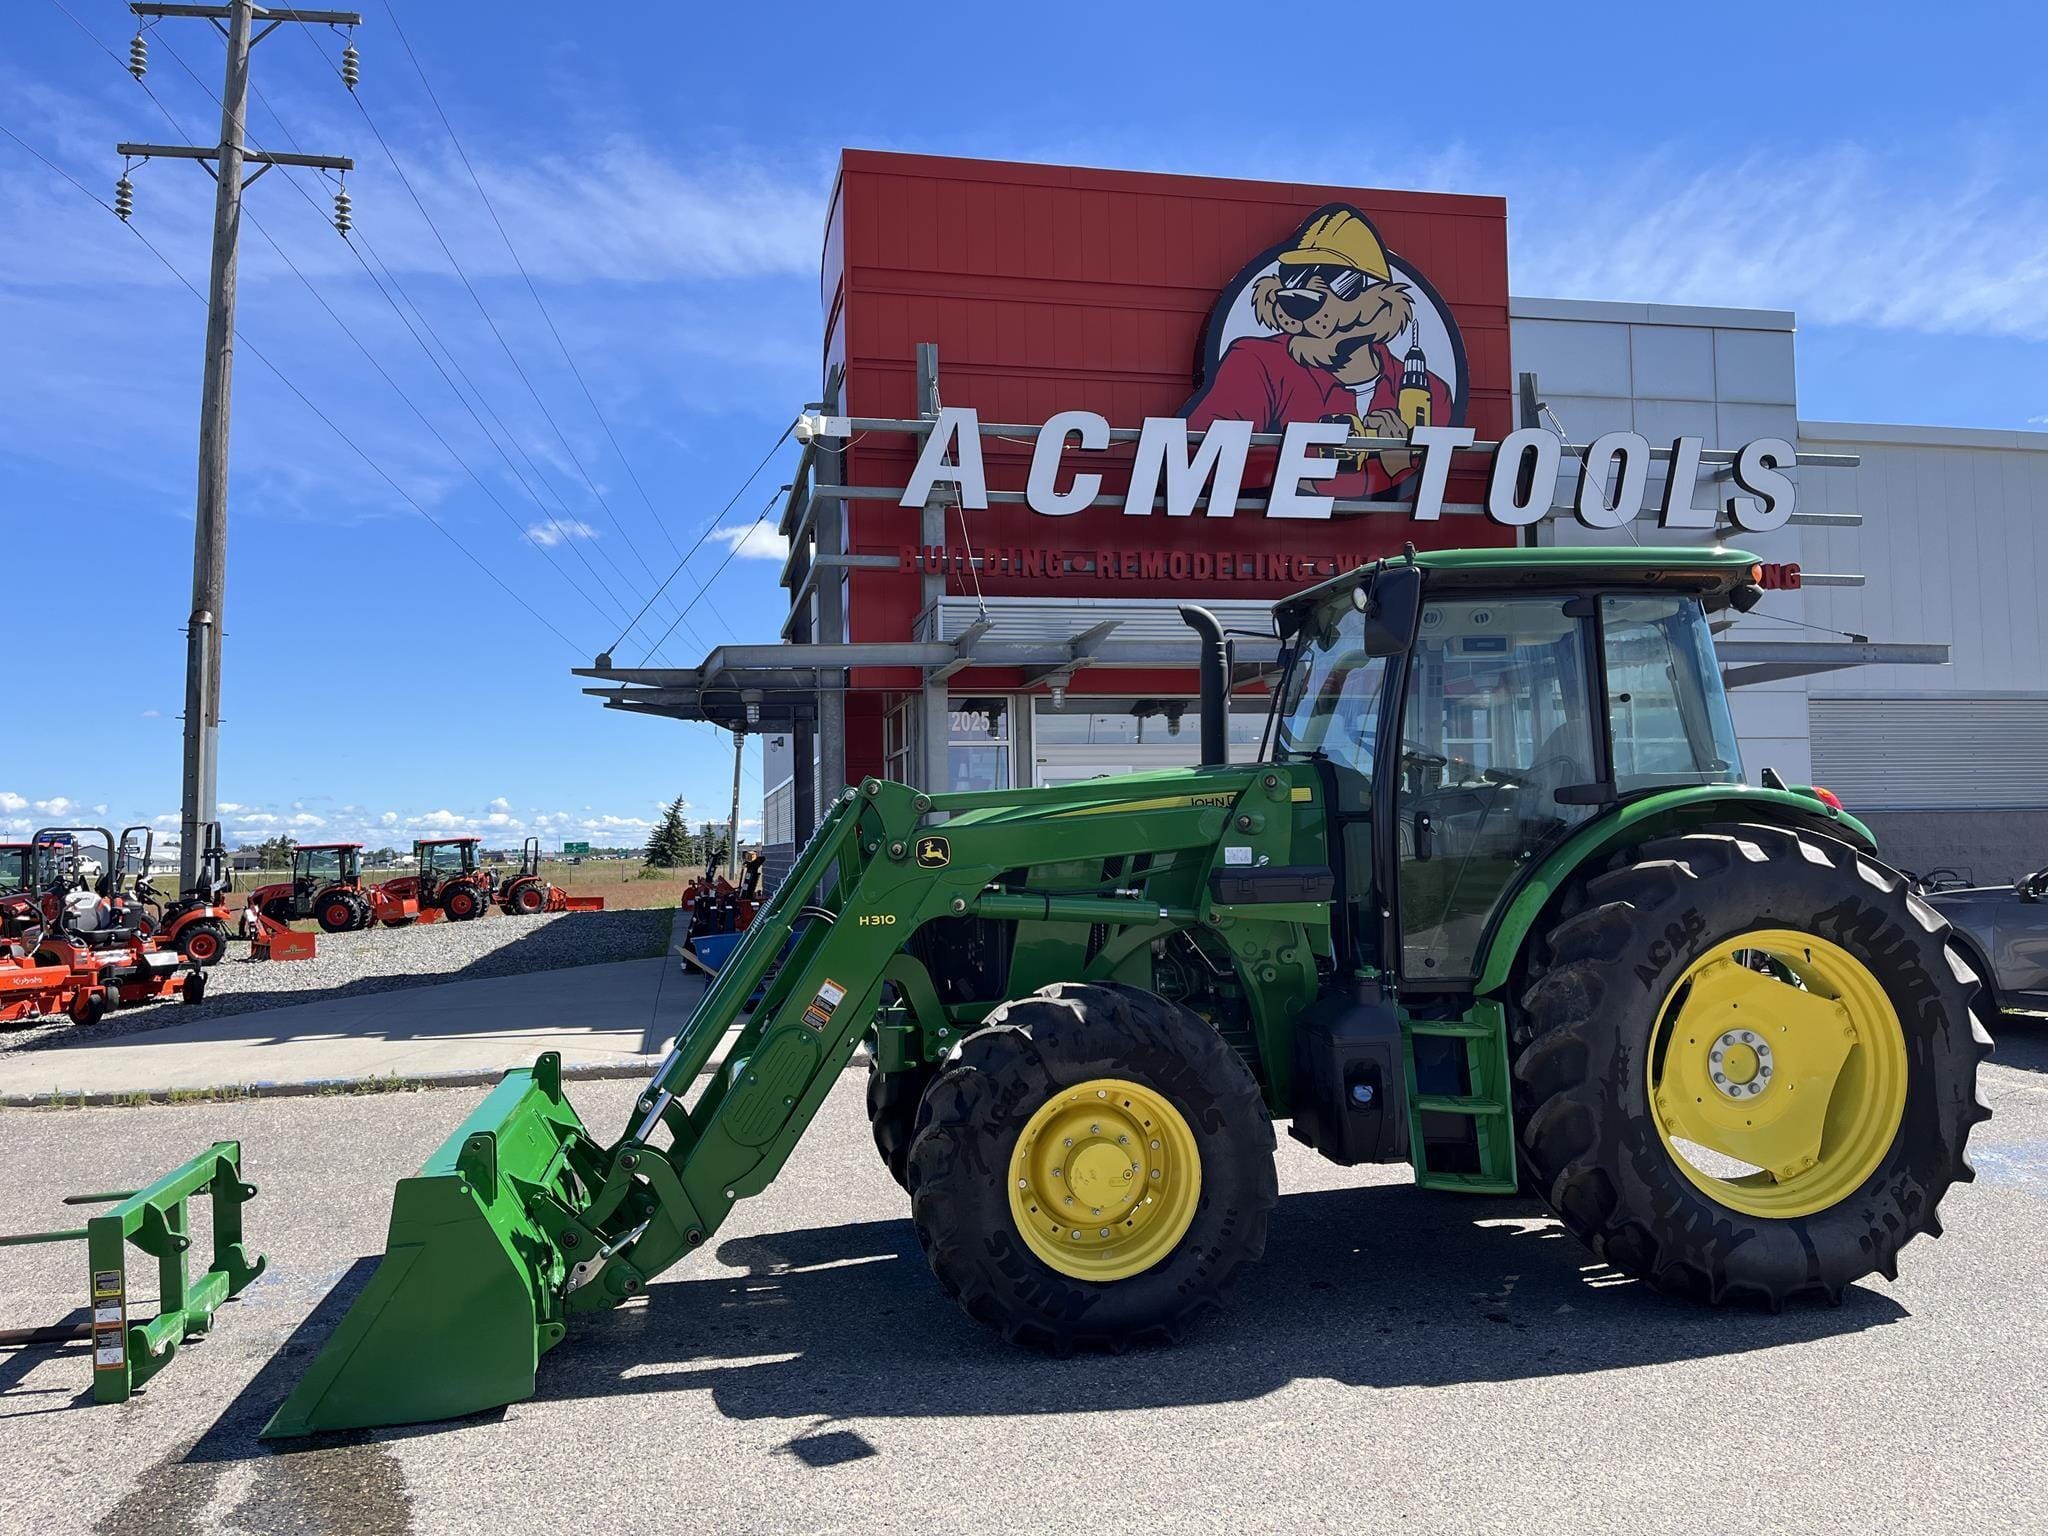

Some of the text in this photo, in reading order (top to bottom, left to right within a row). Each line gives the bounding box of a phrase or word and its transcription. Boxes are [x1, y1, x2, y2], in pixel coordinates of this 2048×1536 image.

[899, 407, 1797, 532] ACME TOOLS
[900, 545, 1065, 579] BUILDING
[1095, 549, 1308, 583] REMODELING
[951, 711, 990, 732] 2025
